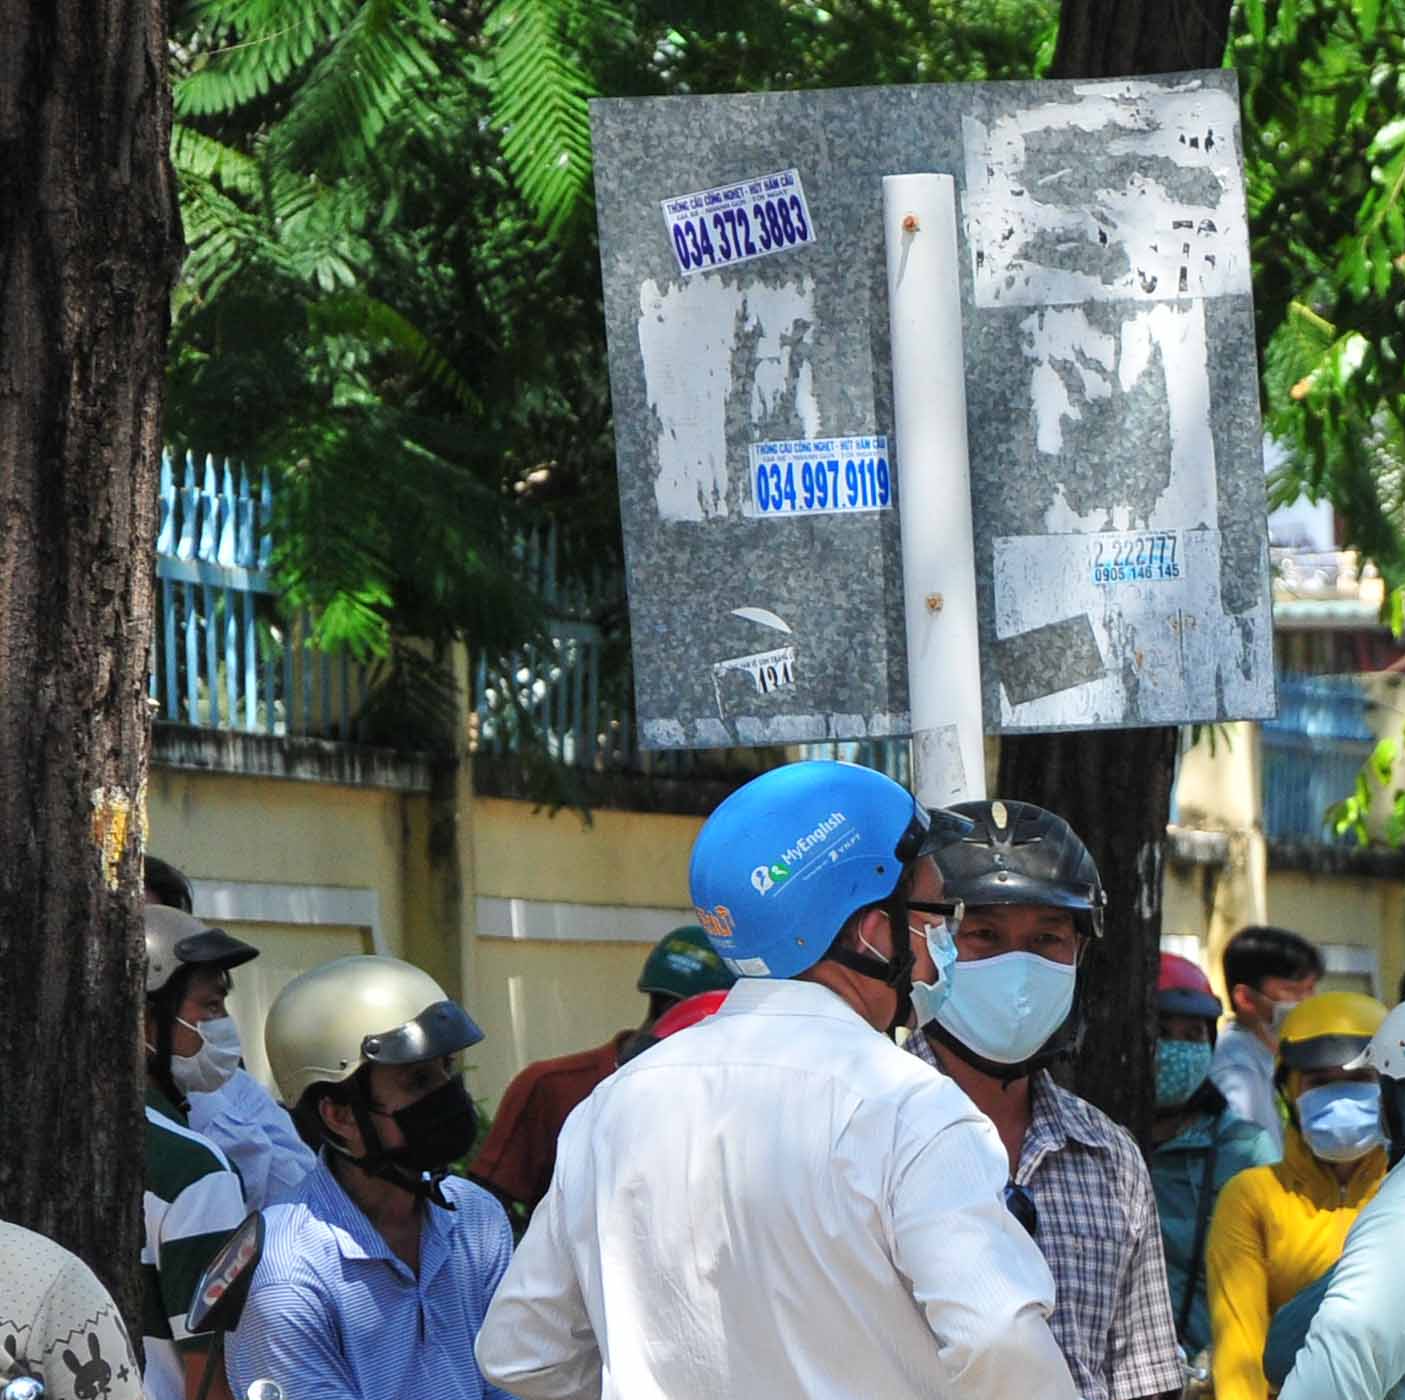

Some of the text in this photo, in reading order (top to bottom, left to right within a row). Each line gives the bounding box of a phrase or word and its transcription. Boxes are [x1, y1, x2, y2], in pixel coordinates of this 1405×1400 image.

[673, 194, 807, 270] 034.372.3883
[757, 457, 889, 511] 034.997.9119
[781, 812, 847, 865] MyEnglish
